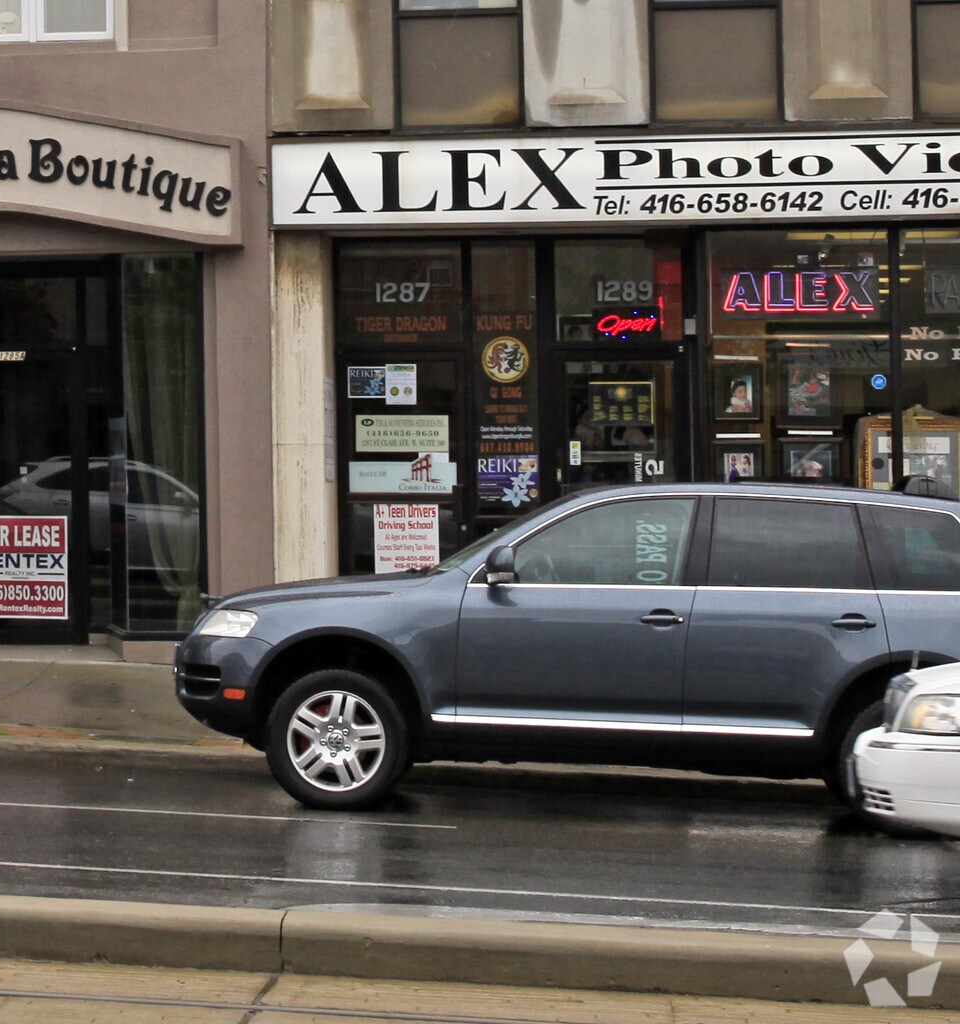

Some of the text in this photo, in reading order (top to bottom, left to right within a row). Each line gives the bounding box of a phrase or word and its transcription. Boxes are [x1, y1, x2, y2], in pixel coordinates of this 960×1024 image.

[28, 138, 232, 217] Boutique
[292, 141, 960, 214] ALEX Photo Vi
[593, 187, 959, 216] Tel: 416-658-6142 Cell: 416-
[376, 282, 430, 303] 1287
[597, 280, 654, 302] 1289
[723, 271, 875, 312] ALEX
[355, 316, 447, 332] TIGER DRAGON
[476, 315, 533, 331] KUNG FU
[597, 314, 657, 336] Open
[909, 326, 944, 340] No
[905, 348, 939, 361] No
[350, 369, 374, 378] REIKI
[477, 458, 517, 472] REIKI
[387, 504, 405, 518] Teen
[408, 504, 436, 518] Drivers
[379, 521, 433, 531] Driving School
[14, 525, 60, 547] LEASE
